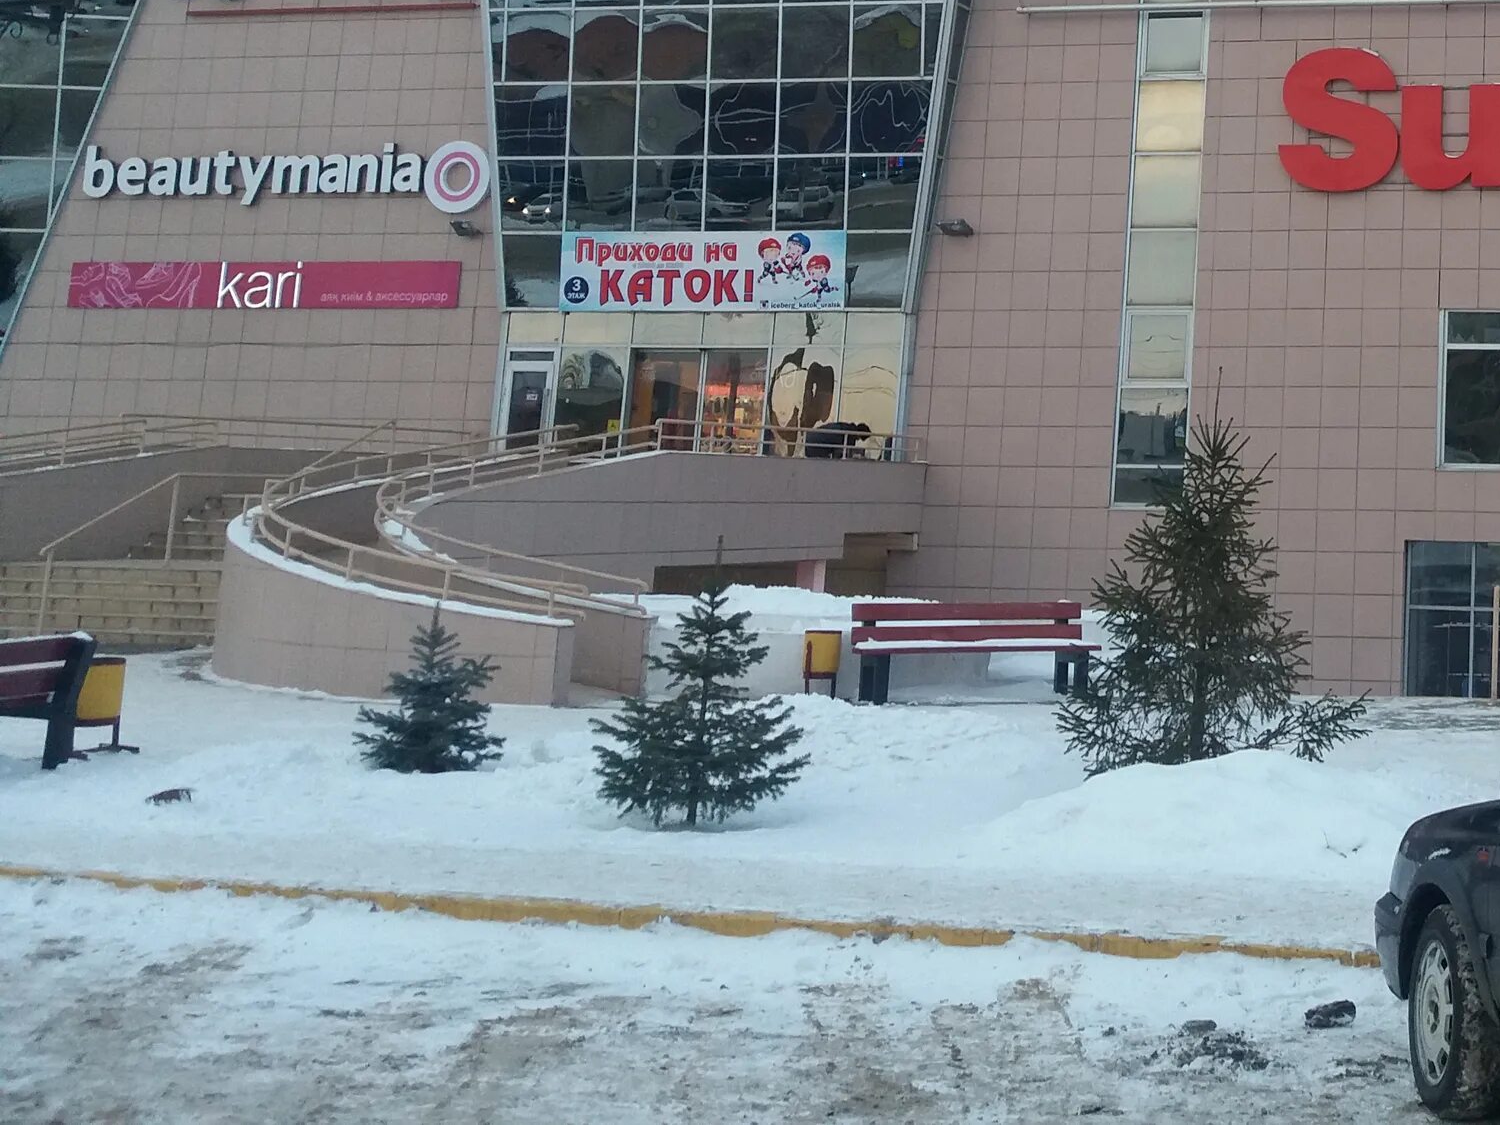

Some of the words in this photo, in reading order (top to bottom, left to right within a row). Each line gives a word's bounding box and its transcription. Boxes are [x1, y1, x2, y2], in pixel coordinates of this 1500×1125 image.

[82, 143, 424, 206] beautymania
[575, 236, 693, 266] Приходи
[703, 243, 737, 263] на
[216, 261, 303, 308] kari
[366, 291, 372, 302] &
[375, 292, 448, 303] аксессуарлар
[572, 279, 581, 292] 3
[600, 269, 754, 306] КАТОК!
